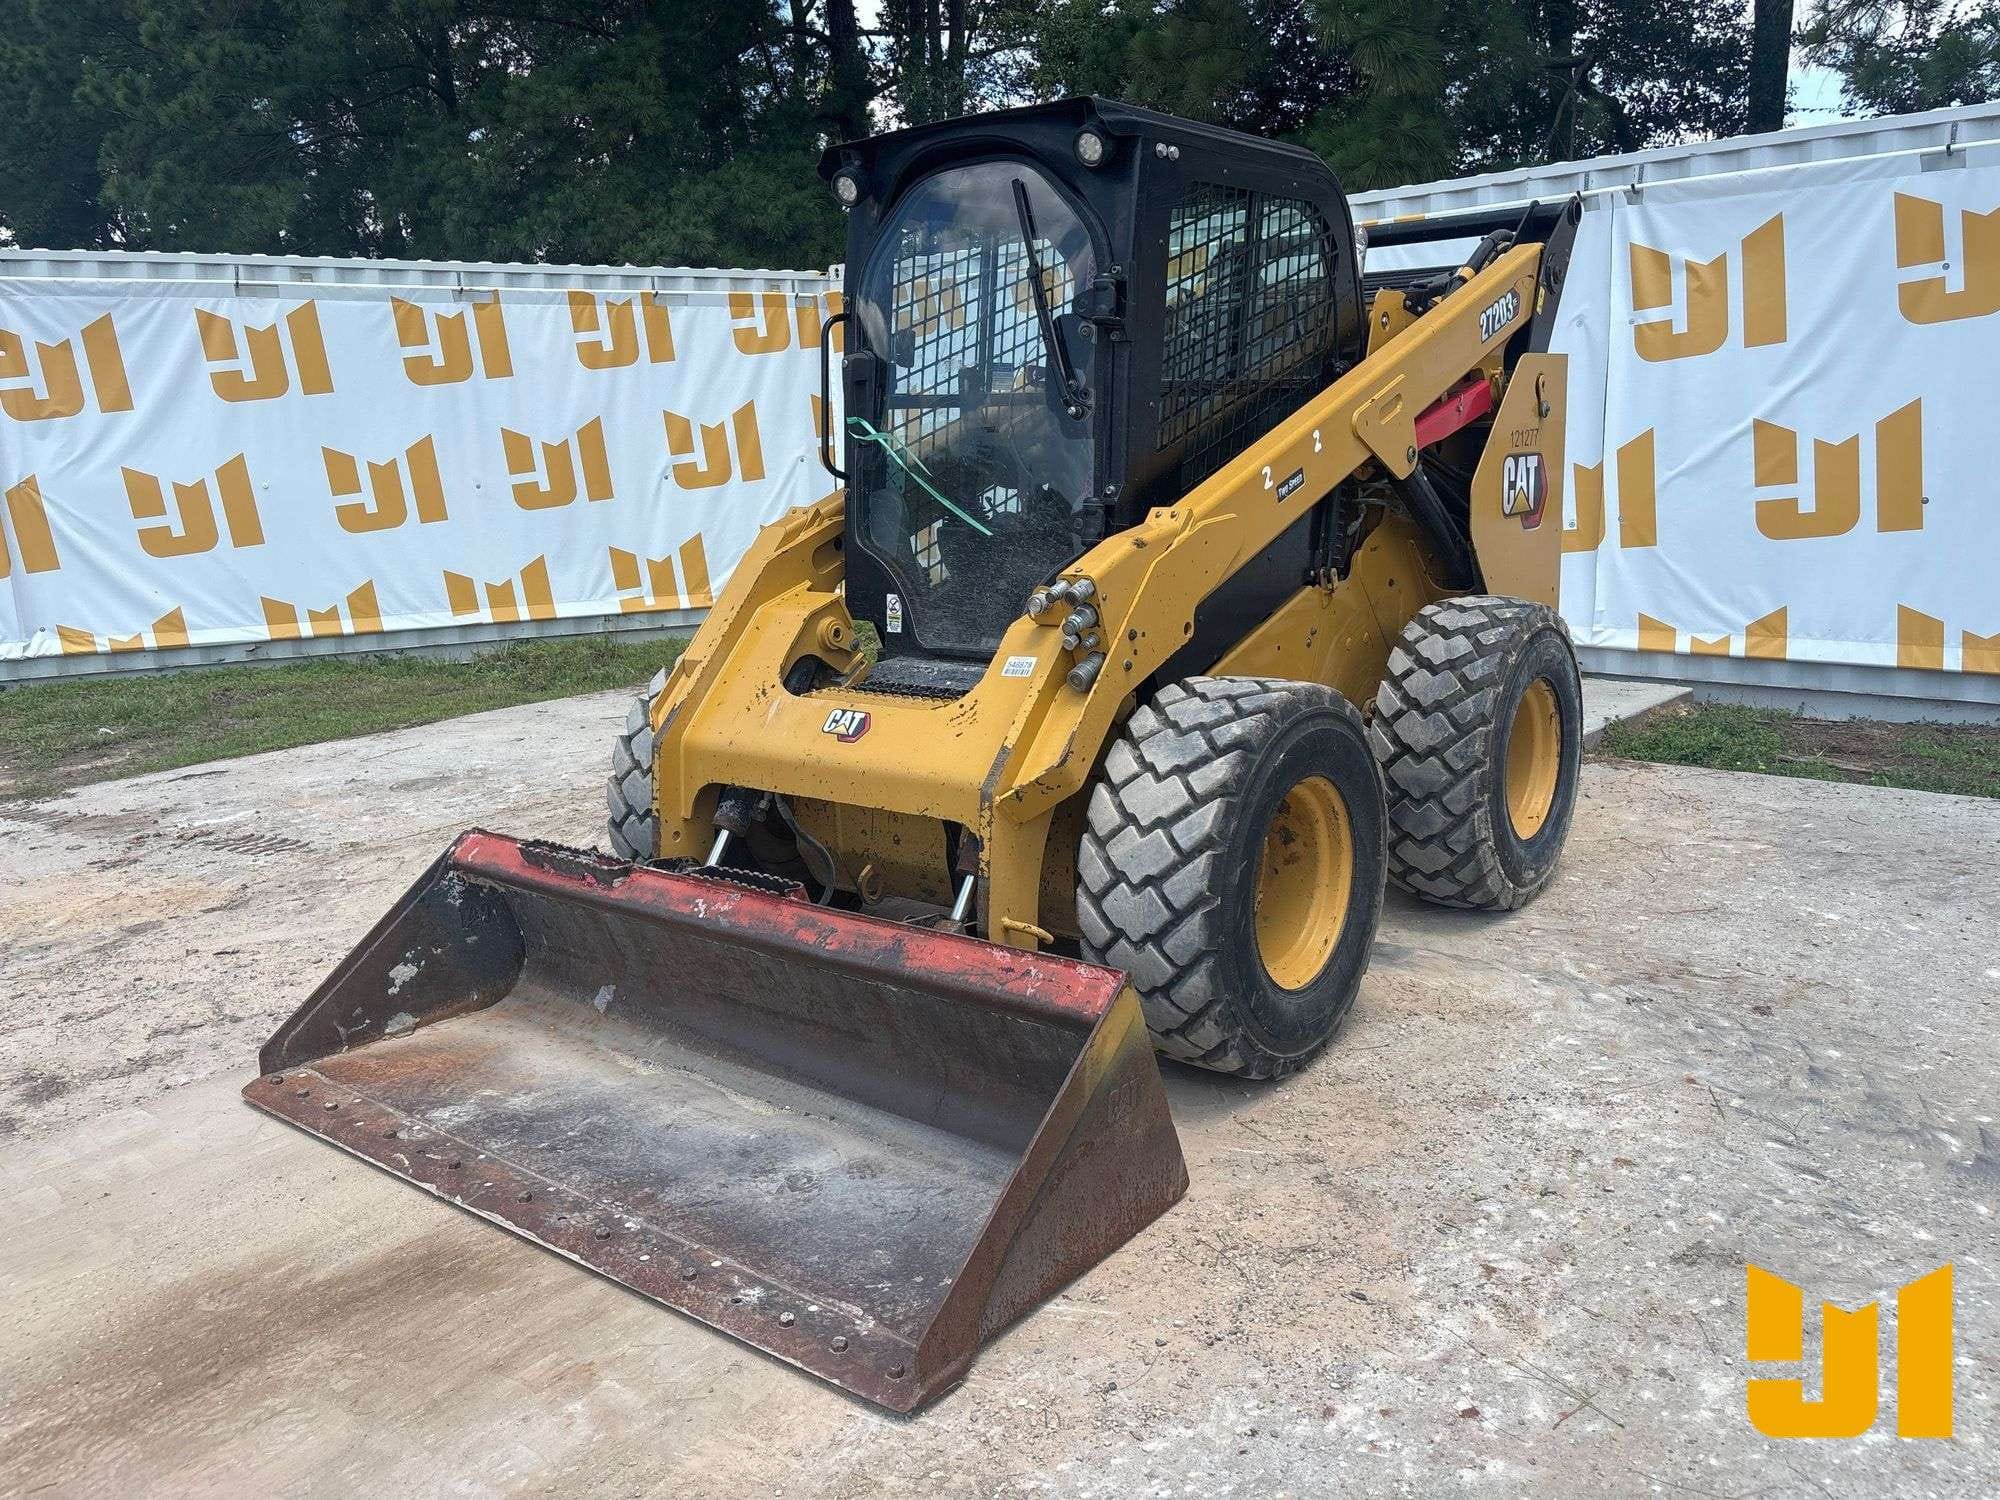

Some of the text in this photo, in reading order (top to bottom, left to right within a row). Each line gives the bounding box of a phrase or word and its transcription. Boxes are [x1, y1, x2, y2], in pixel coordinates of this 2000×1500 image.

[1510, 428, 1540, 449] 121277
[1262, 466, 1273, 490] 2
[1503, 455, 1539, 516] CAT
[823, 709, 867, 737] CAT
